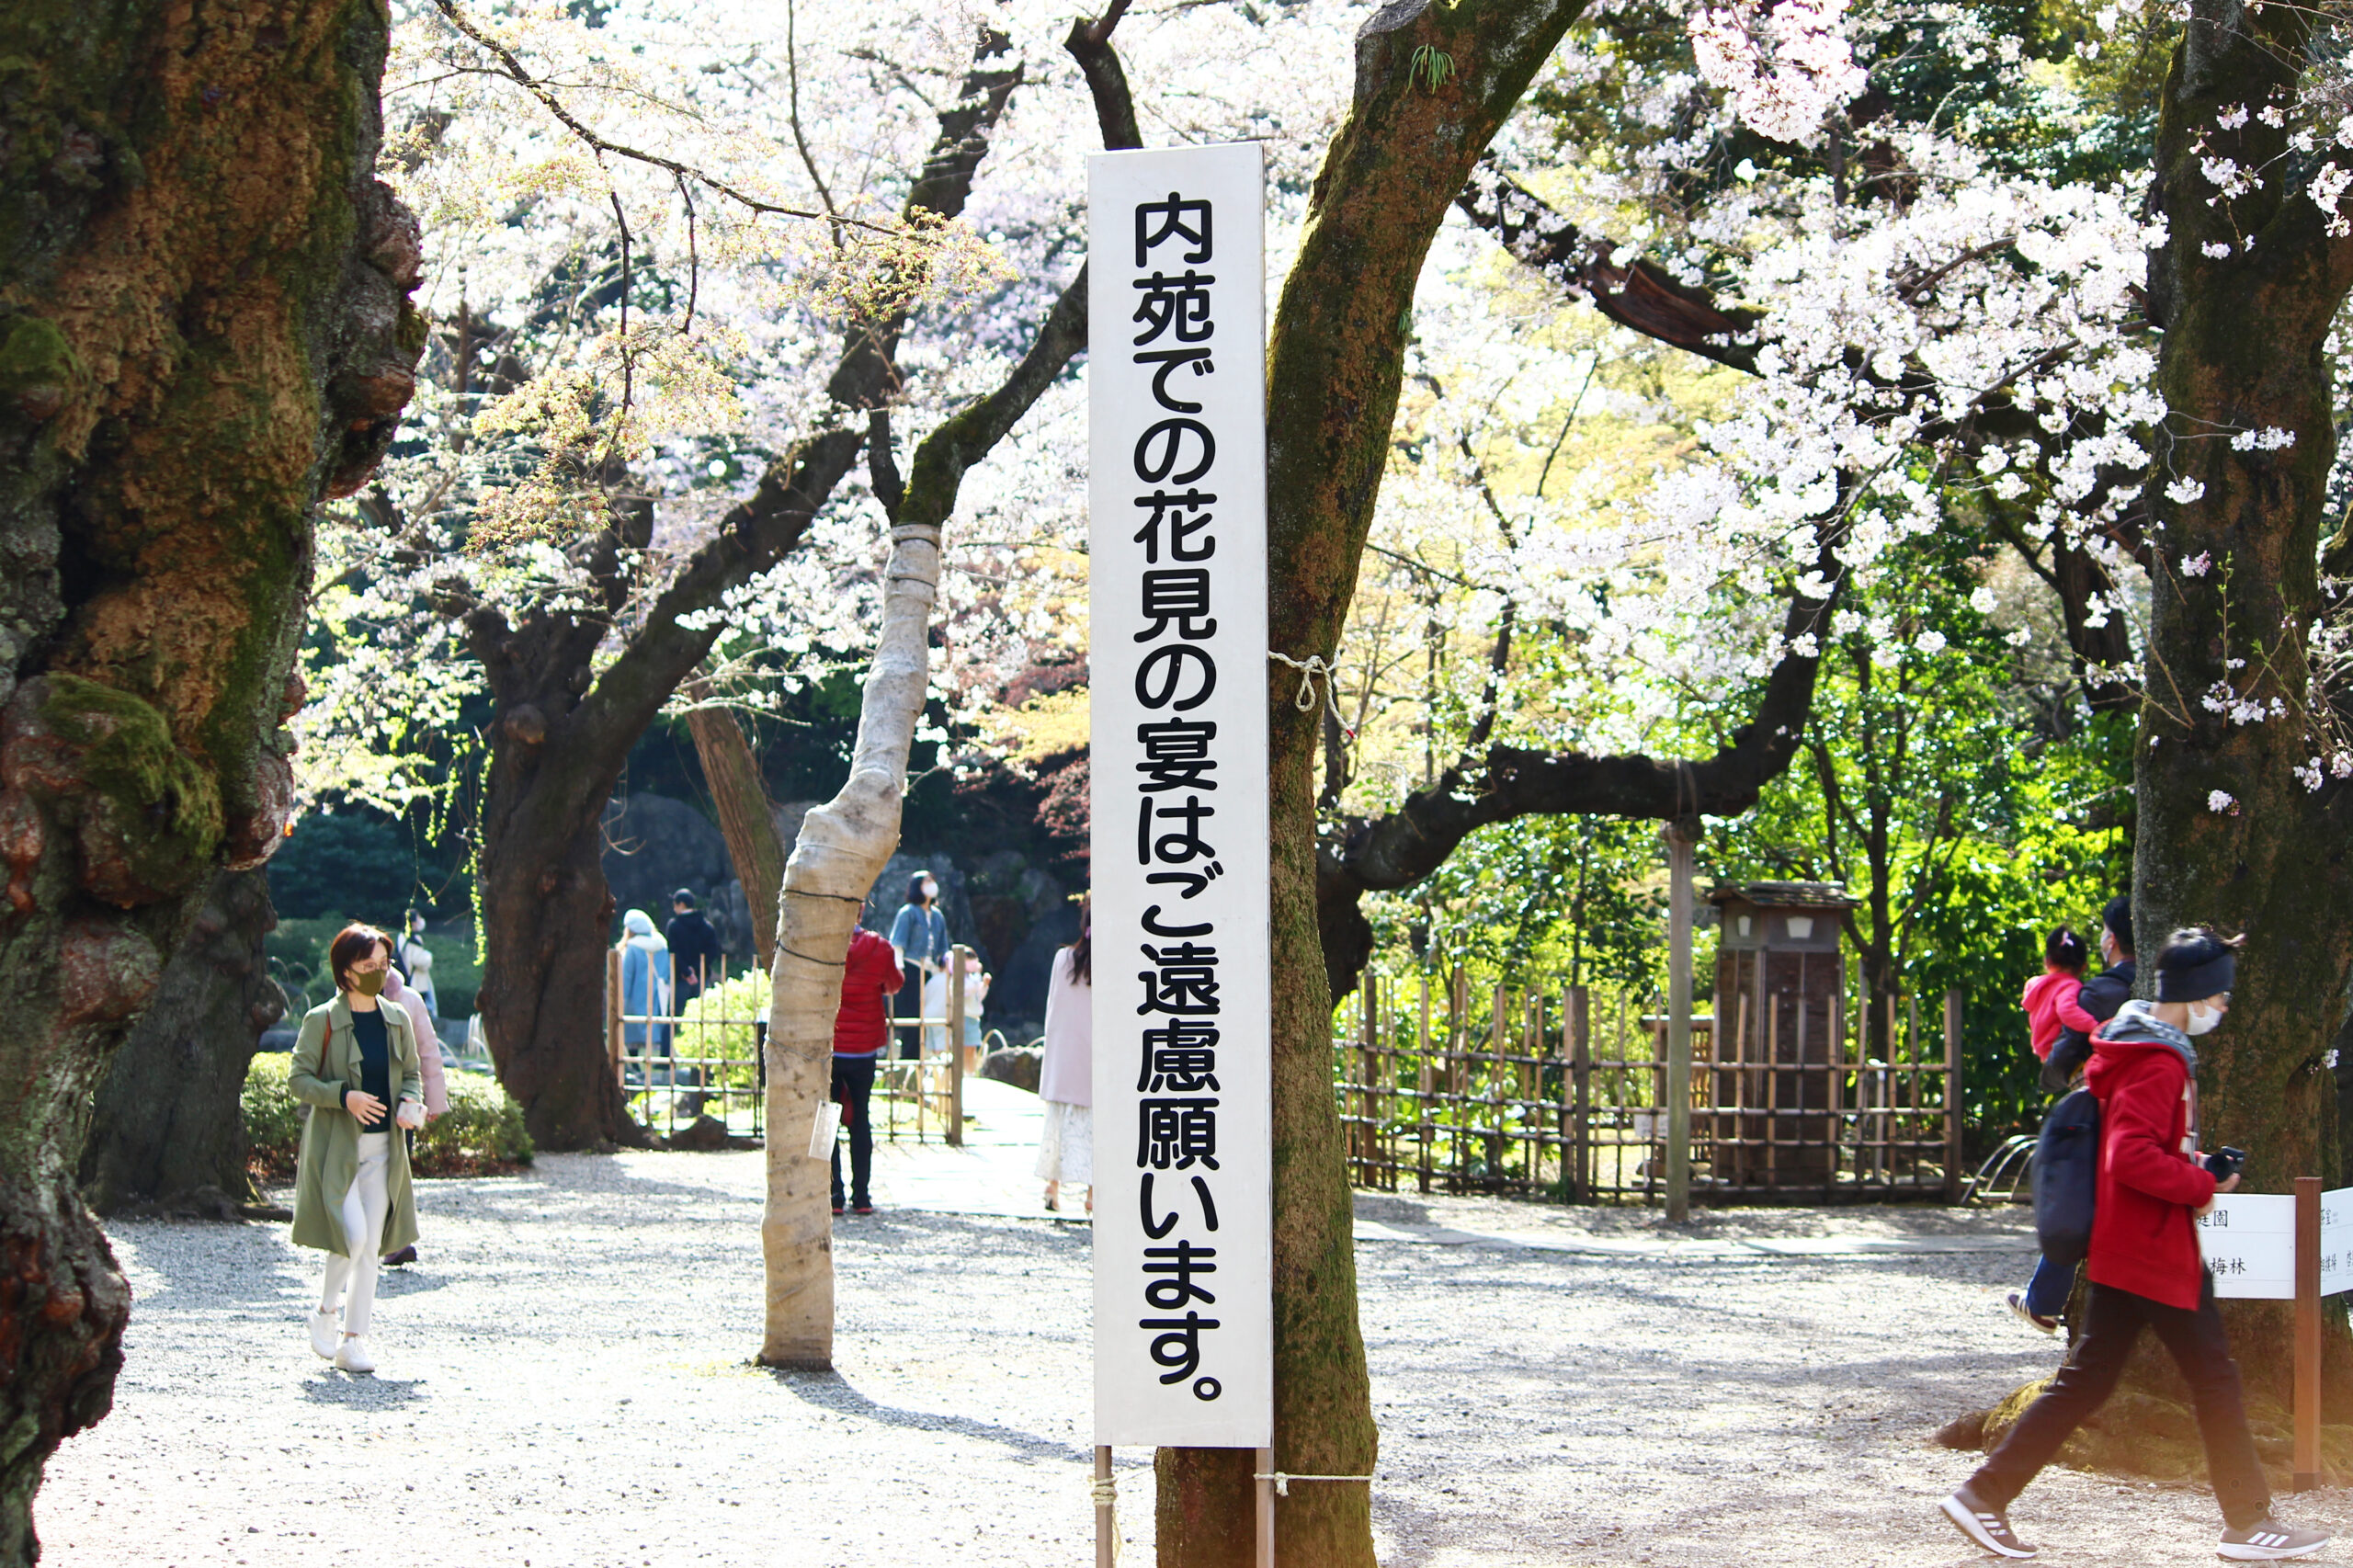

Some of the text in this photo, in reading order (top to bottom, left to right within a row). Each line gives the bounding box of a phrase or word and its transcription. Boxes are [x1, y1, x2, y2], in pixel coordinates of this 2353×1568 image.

[1131, 190, 1223, 1402] 内苑での花見の宴はご遠慮願います。
[2210, 1257, 2246, 1275] 梅林
